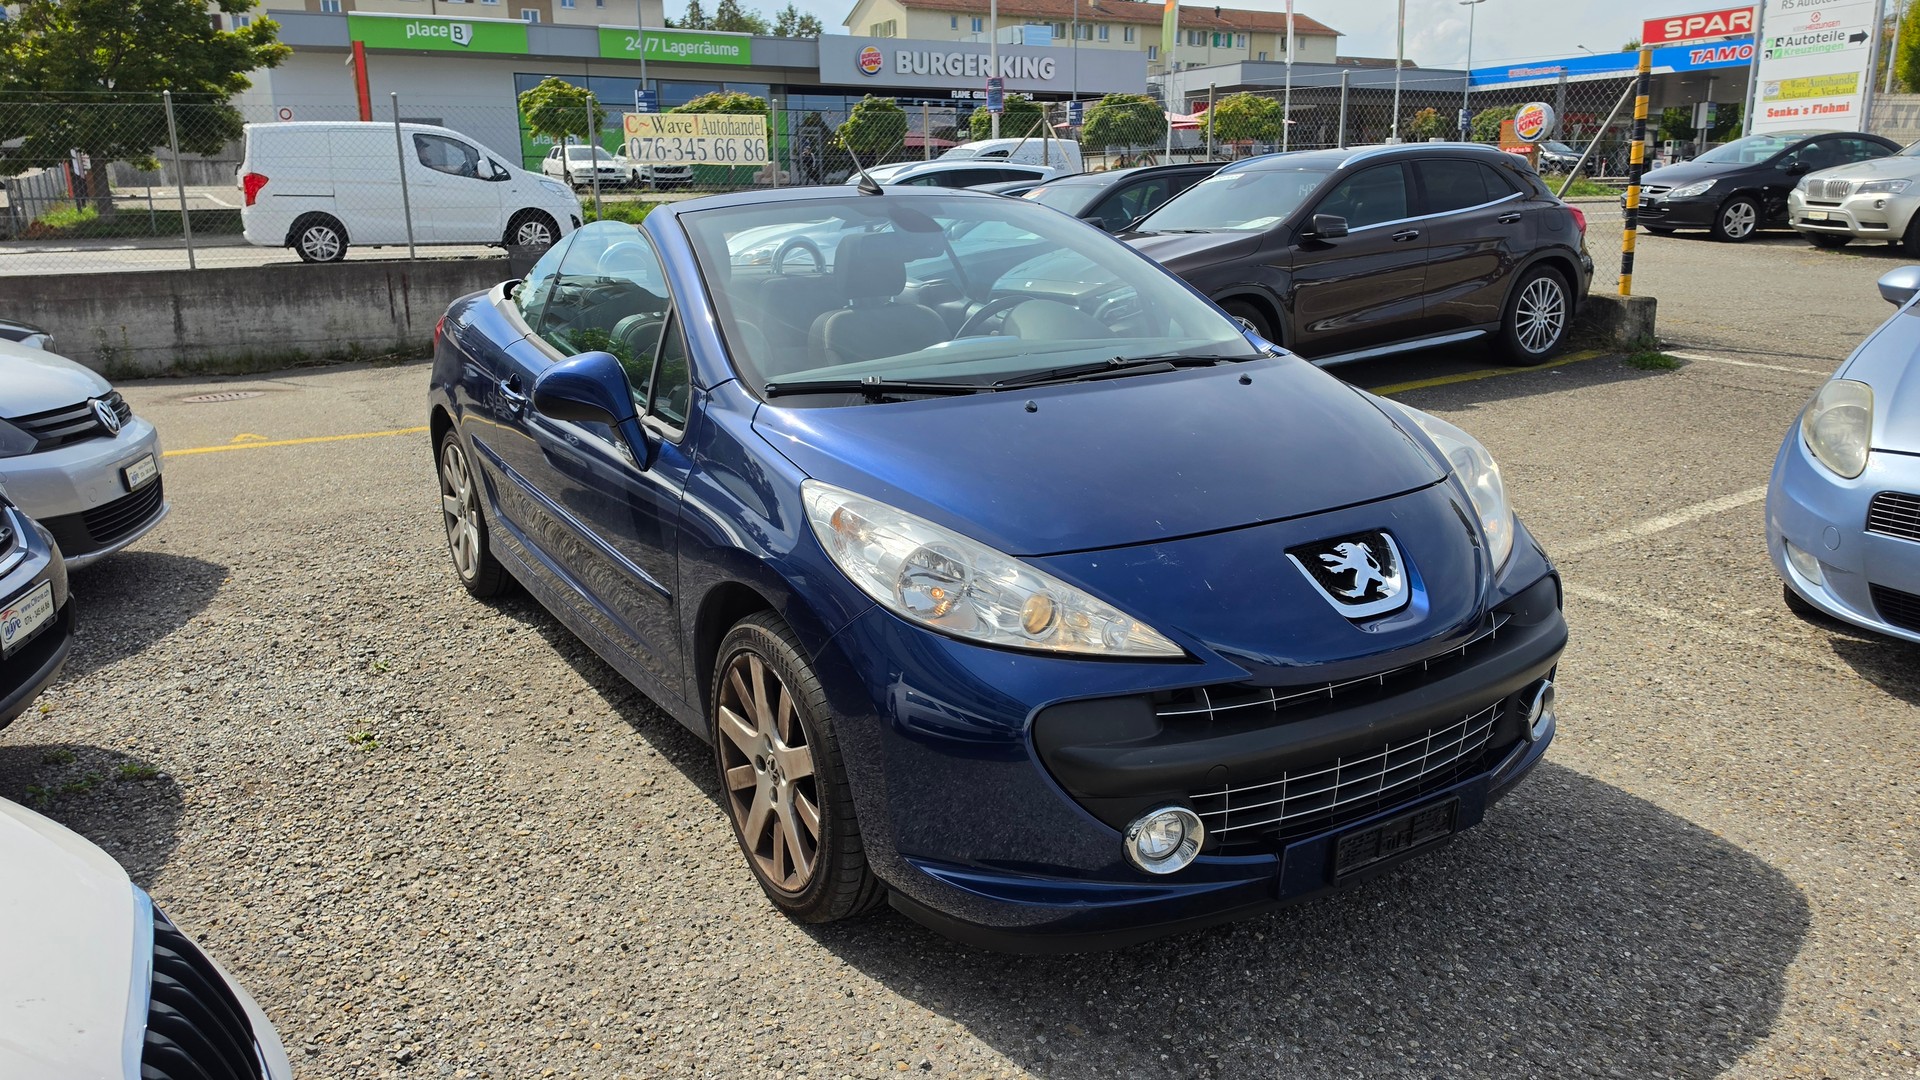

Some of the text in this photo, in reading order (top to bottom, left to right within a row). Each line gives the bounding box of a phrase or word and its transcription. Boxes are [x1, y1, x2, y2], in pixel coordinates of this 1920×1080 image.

[1664, 11, 1752, 38] SPAR
[625, 36, 740, 57] 24/7 Lagerräume
[1785, 30, 1846, 47] Autoteile
[1783, 42, 1845, 56] Kreuzlingen
[860, 58, 882, 67] KING
[895, 50, 1056, 80] BURGER KING
[1821, 84, 1857, 96] Verkauf
[1812, 101, 1850, 114] Flohmi
[701, 115, 765, 136] Autohandel
[1518, 115, 1543, 132] KING
[630, 137, 766, 162] 076-345 66 86
